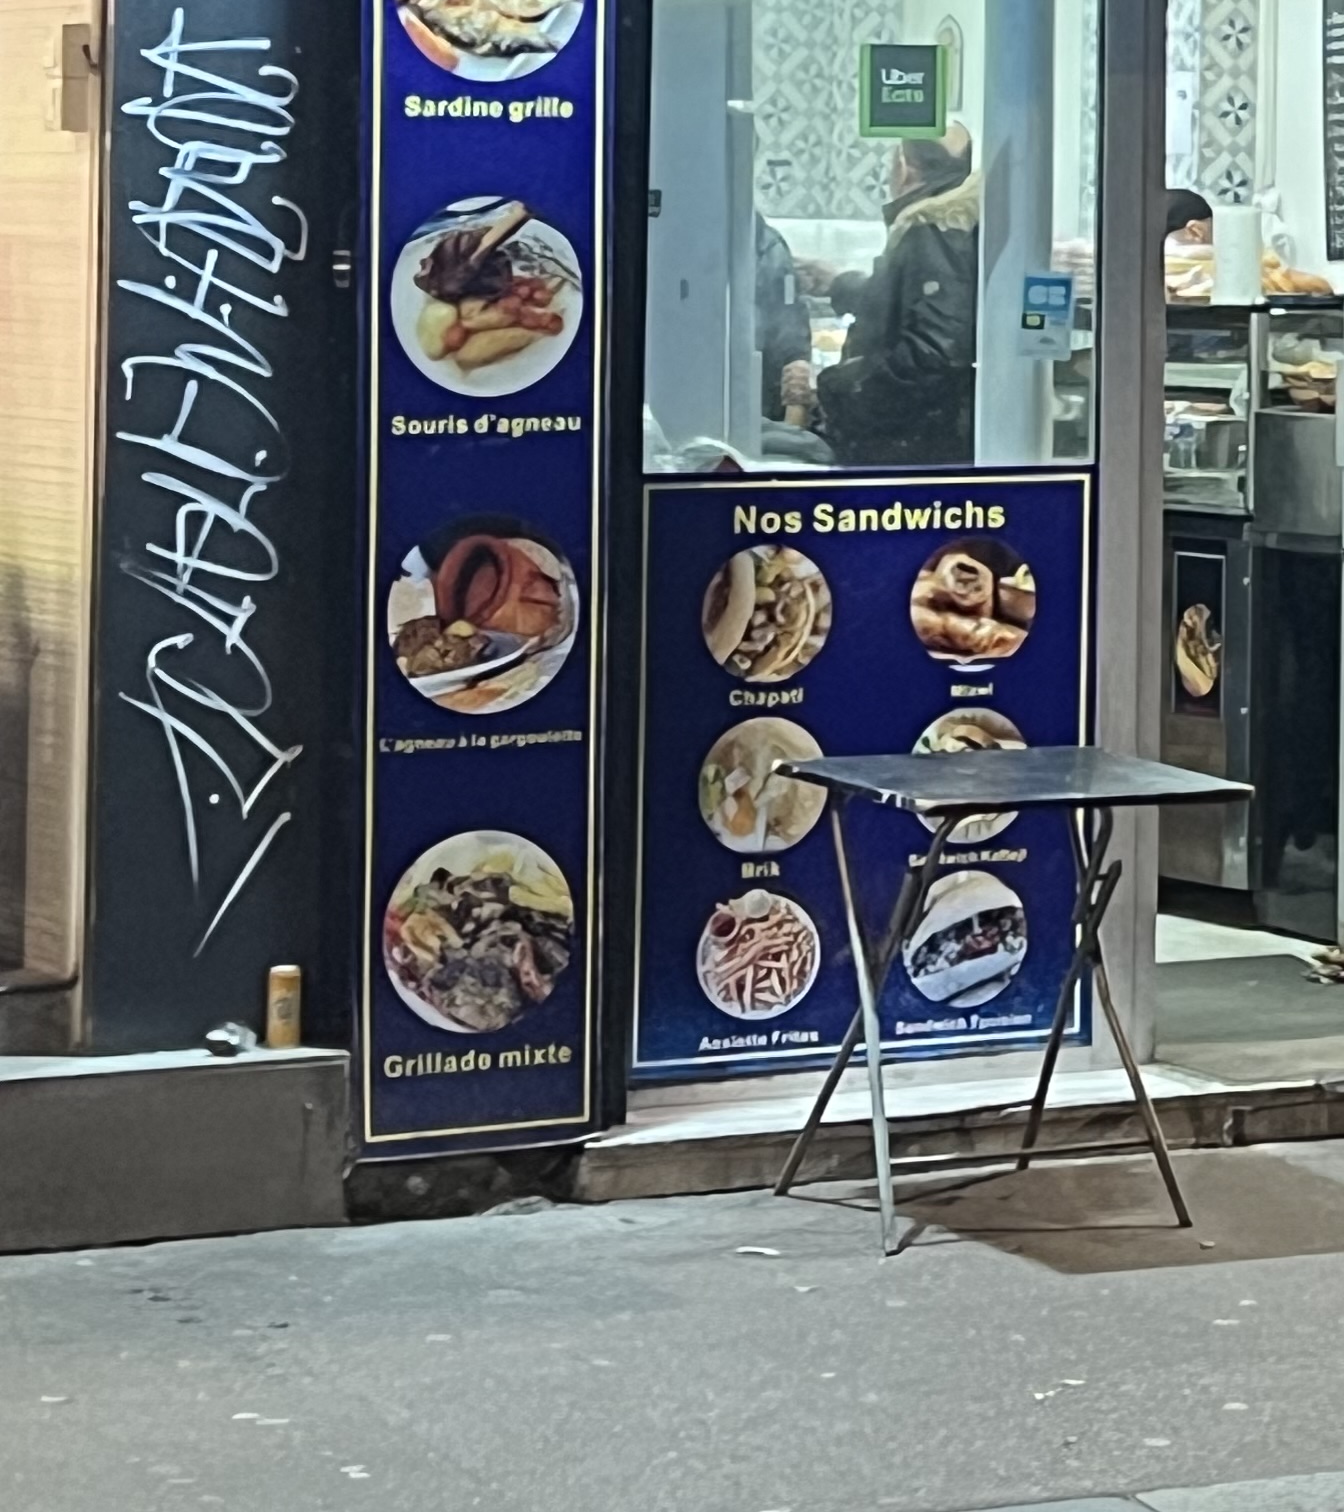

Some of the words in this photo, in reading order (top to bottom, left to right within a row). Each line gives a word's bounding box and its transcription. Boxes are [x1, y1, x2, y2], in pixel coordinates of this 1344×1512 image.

[391, 414, 468, 436] Souris
[474, 413, 581, 438] d'agneau
[732, 504, 803, 535] Nos
[812, 500, 1006, 534] Sandwichs
[498, 1043, 573, 1069] mixte
